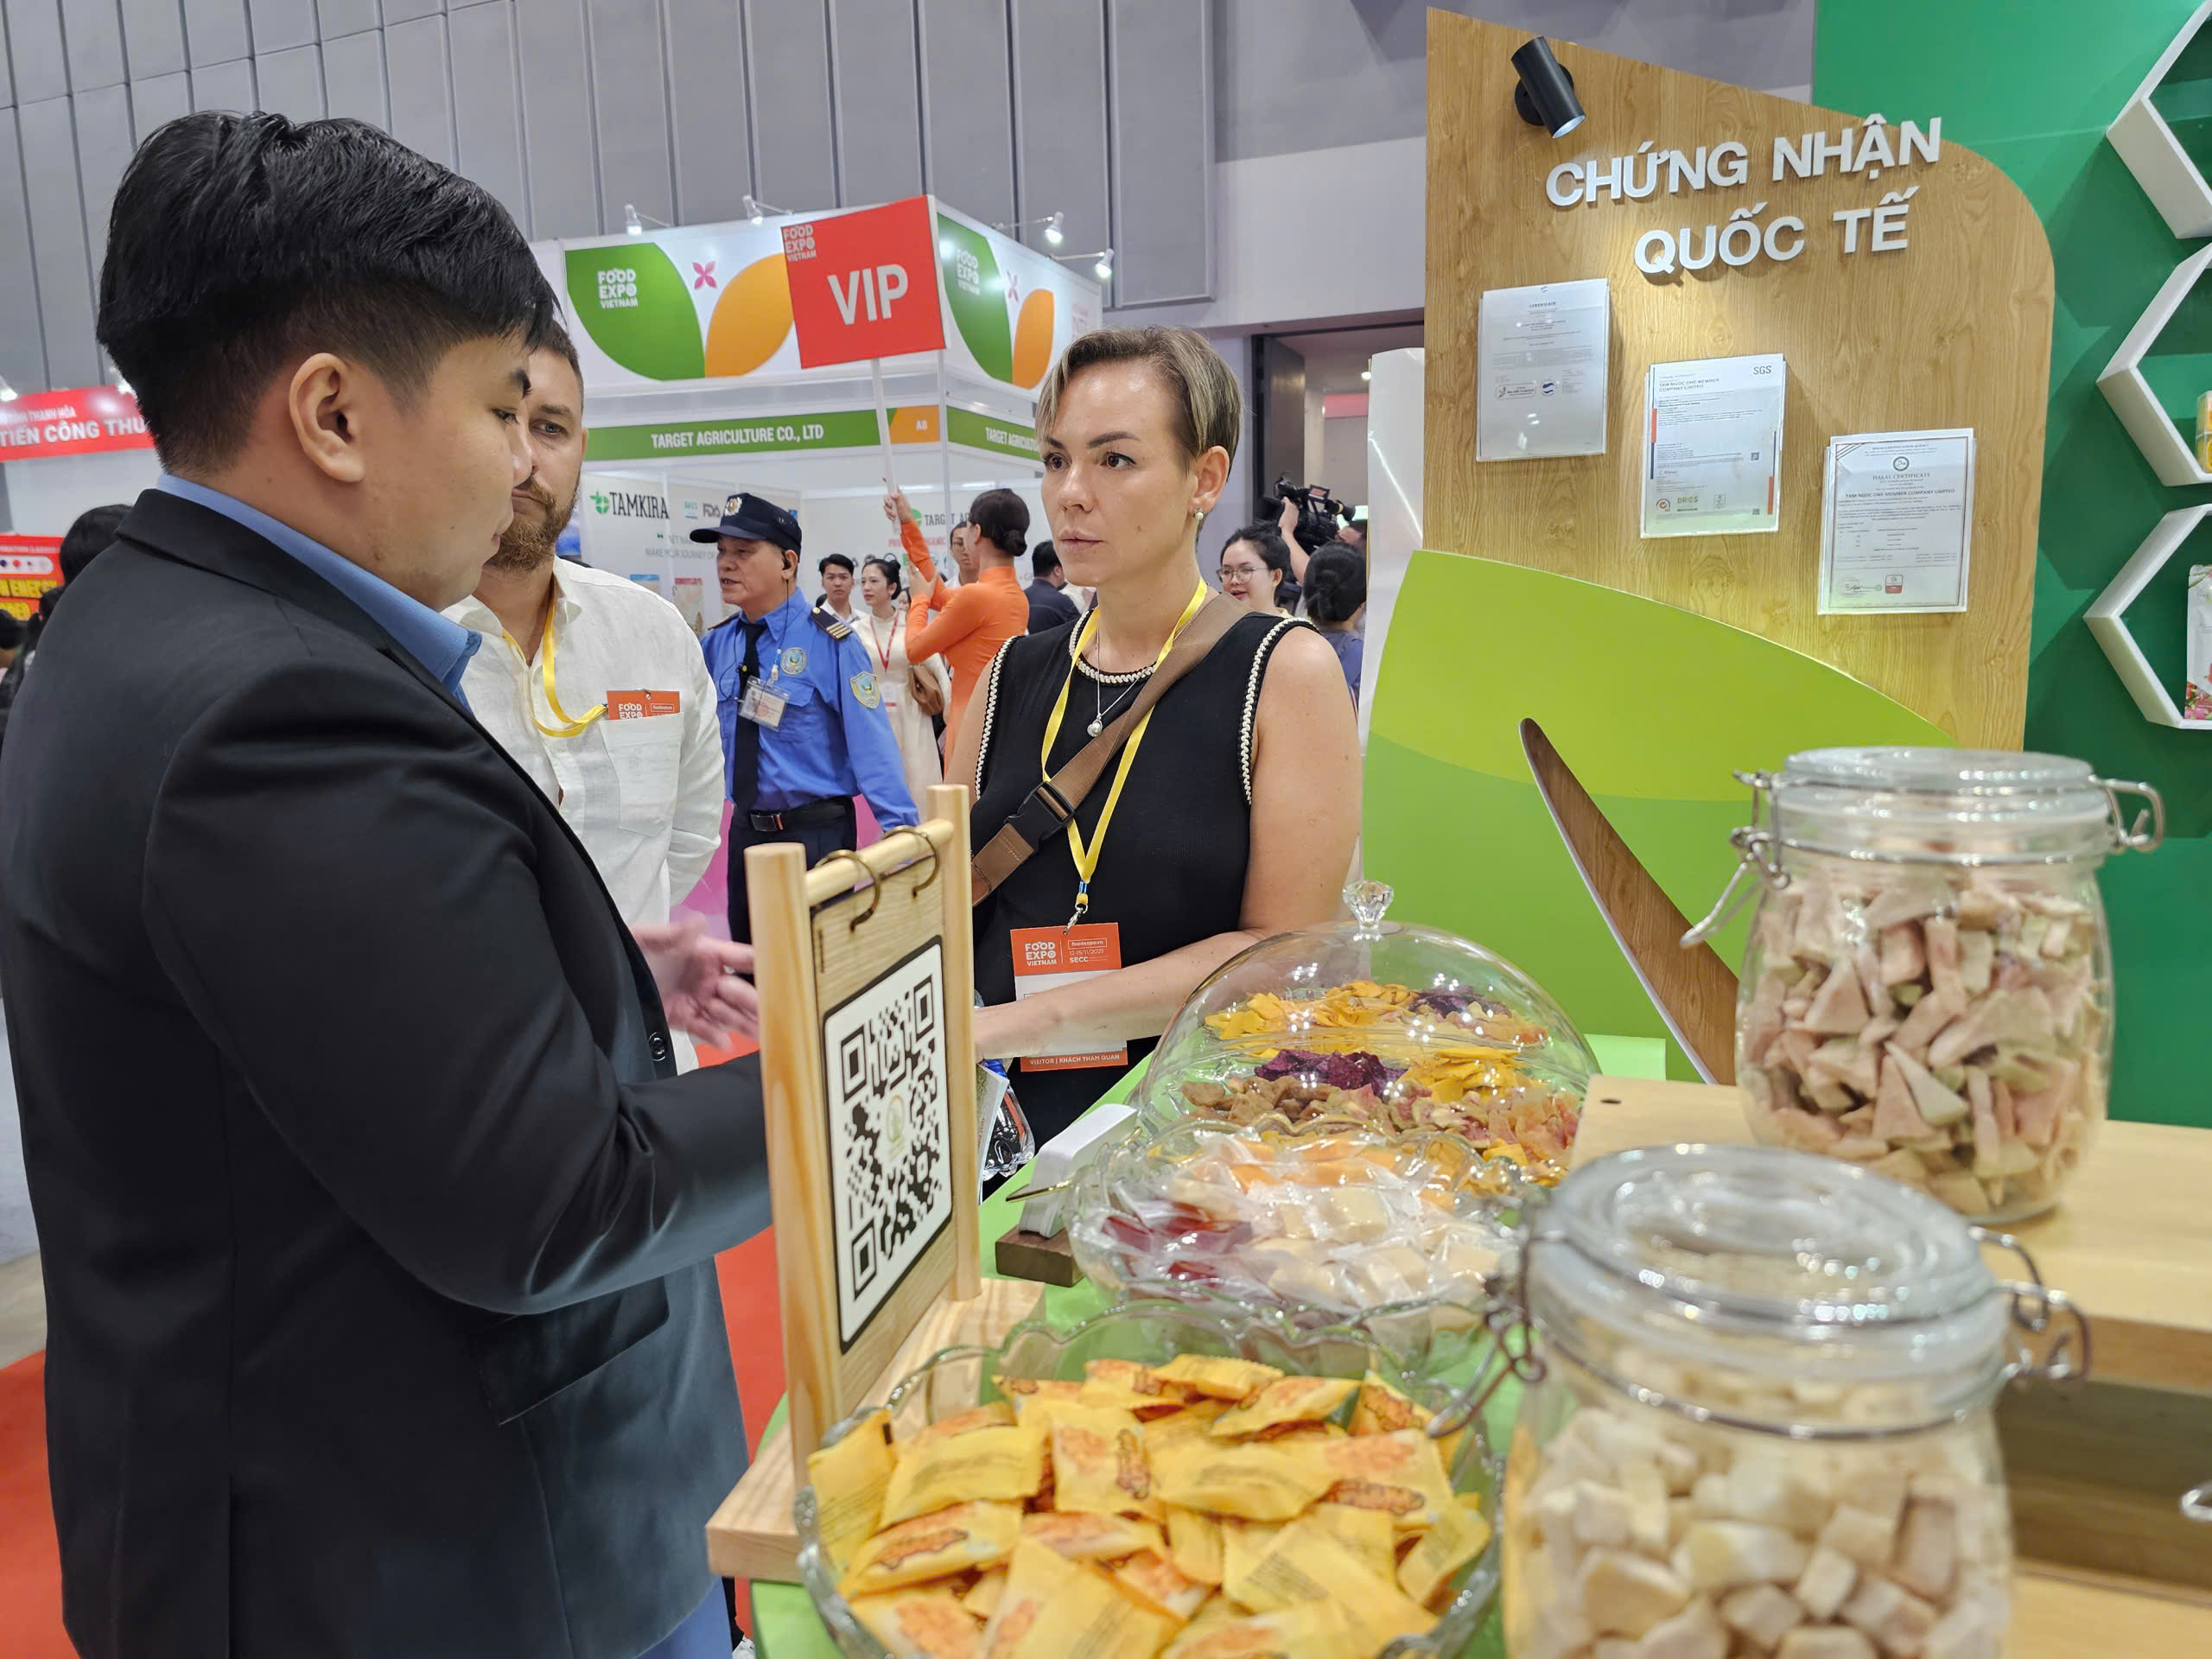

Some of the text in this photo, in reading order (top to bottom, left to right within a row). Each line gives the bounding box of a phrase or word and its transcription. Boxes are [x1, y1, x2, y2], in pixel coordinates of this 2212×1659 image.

[1546, 113, 1942, 207] CHỨNG NHẬN
[783, 225, 814, 240] FOOD
[1634, 186, 1920, 274] QUỐC TẾ
[785, 237, 816, 254] EXPO
[786, 251, 817, 262] VIETNAM
[597, 268, 636, 284] FOOD
[599, 283, 637, 299] EXPO
[827, 264, 908, 325] VIP
[600, 297, 639, 309] VIETNAM
[1753, 365, 1772, 375] SGS
[44, 420, 100, 443] CÔNG
[651, 424, 824, 448] TARGET AGRICULTURE CO., LTD
[609, 492, 671, 519] TAMKIRA
[702, 503, 721, 518] FDA
[925, 513, 956, 526] TARGT
[618, 702, 642, 711] FOOD
[1025, 941, 1056, 951] FOOD
[1026, 950, 1057, 960] EXPO
